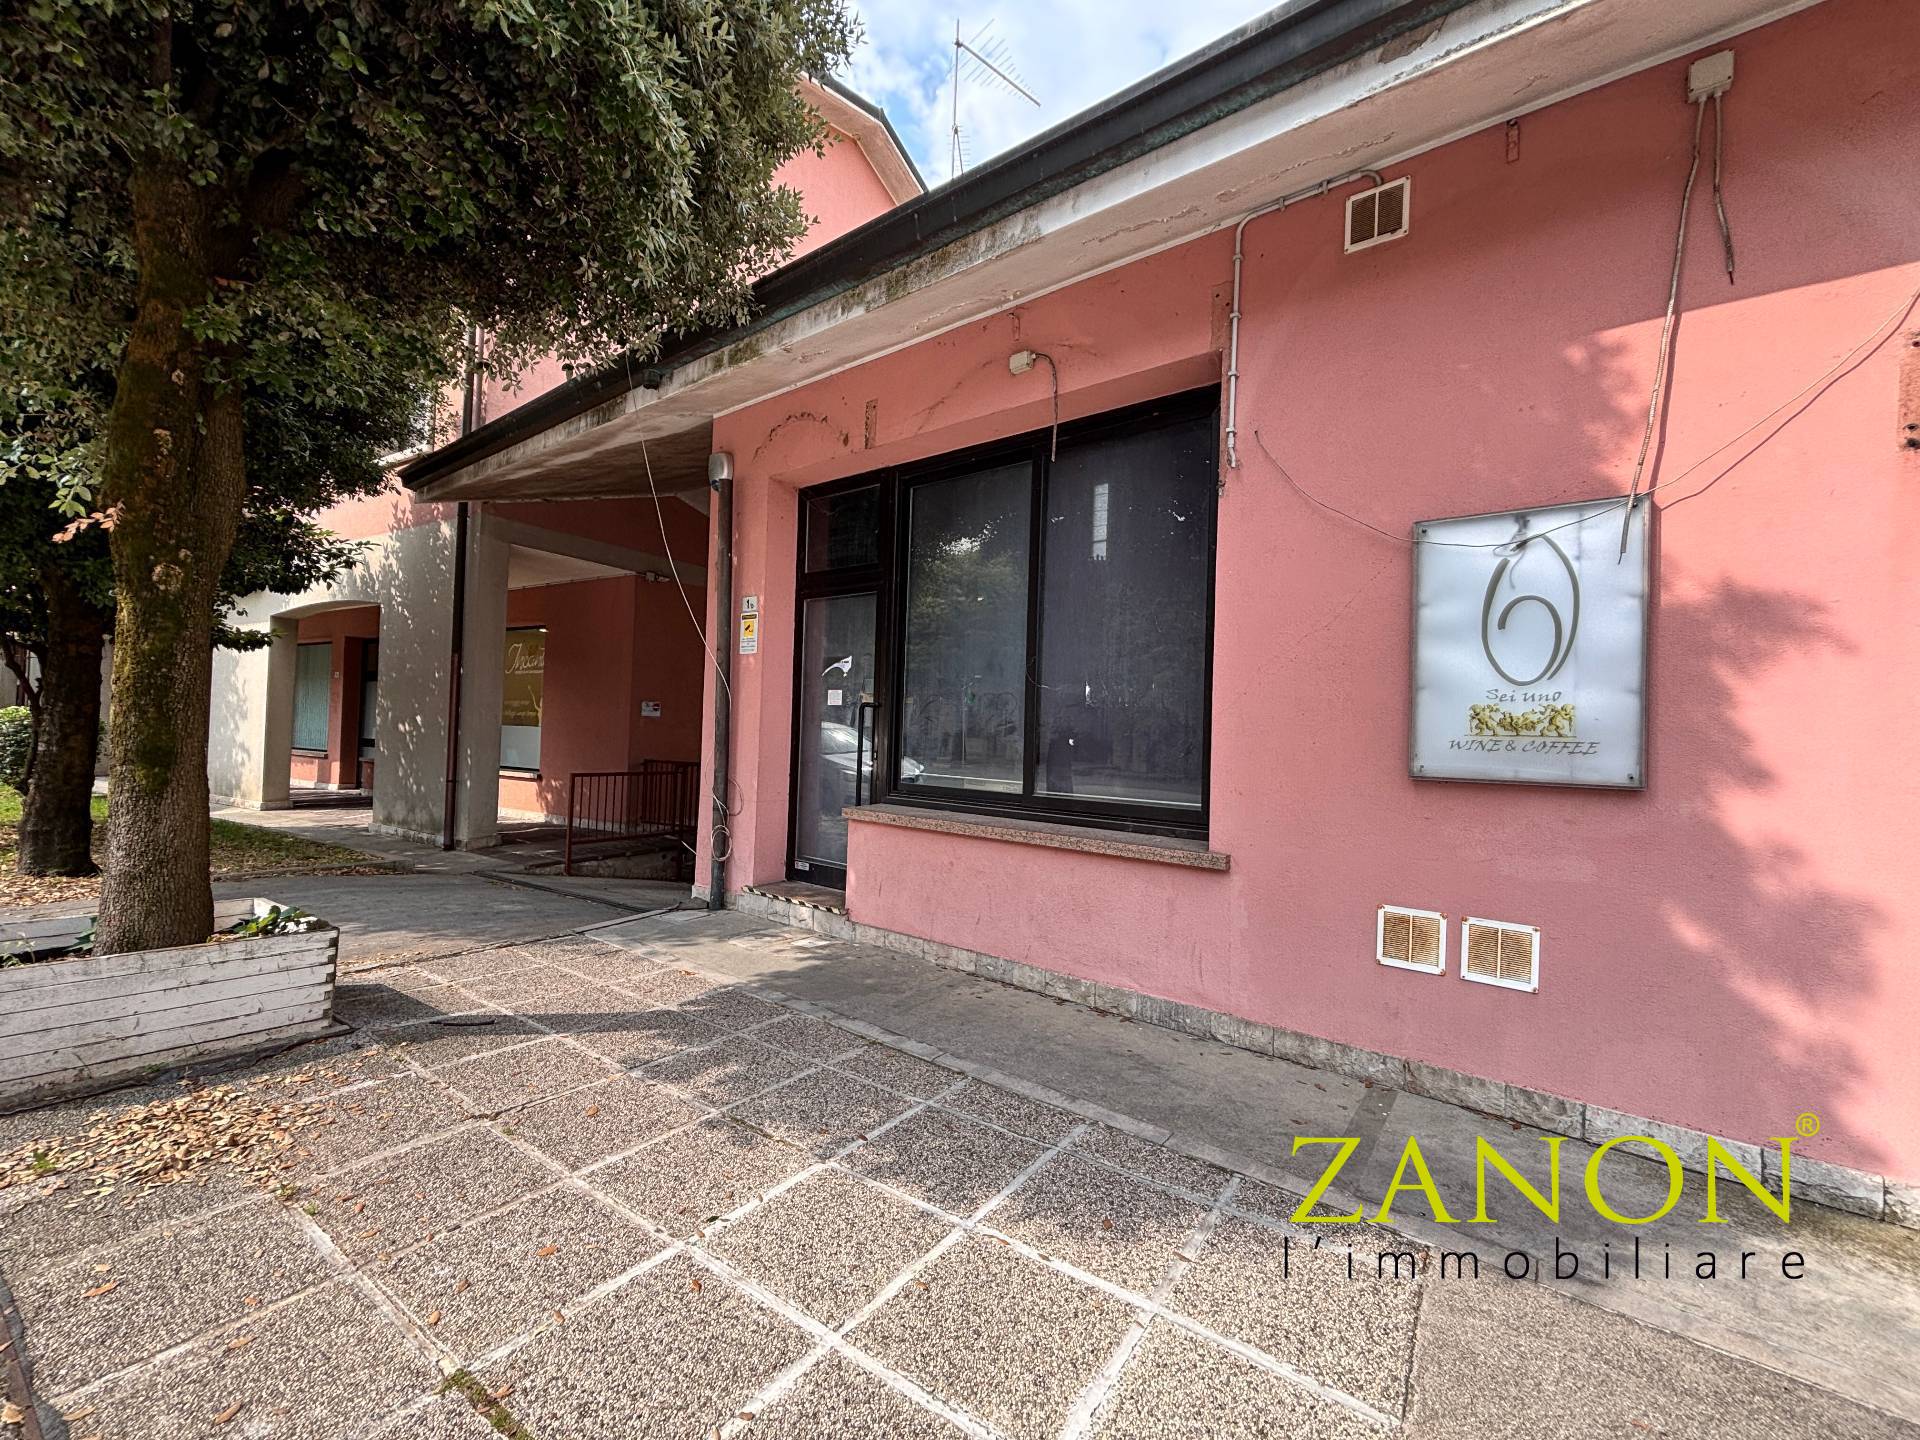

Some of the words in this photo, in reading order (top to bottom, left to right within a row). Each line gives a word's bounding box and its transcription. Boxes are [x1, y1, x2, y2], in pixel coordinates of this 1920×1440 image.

[1485, 689, 1517, 703] Sei
[1449, 738, 1503, 753] WINE
[1504, 738, 1517, 752] &
[1521, 740, 1601, 756] COFFEE
